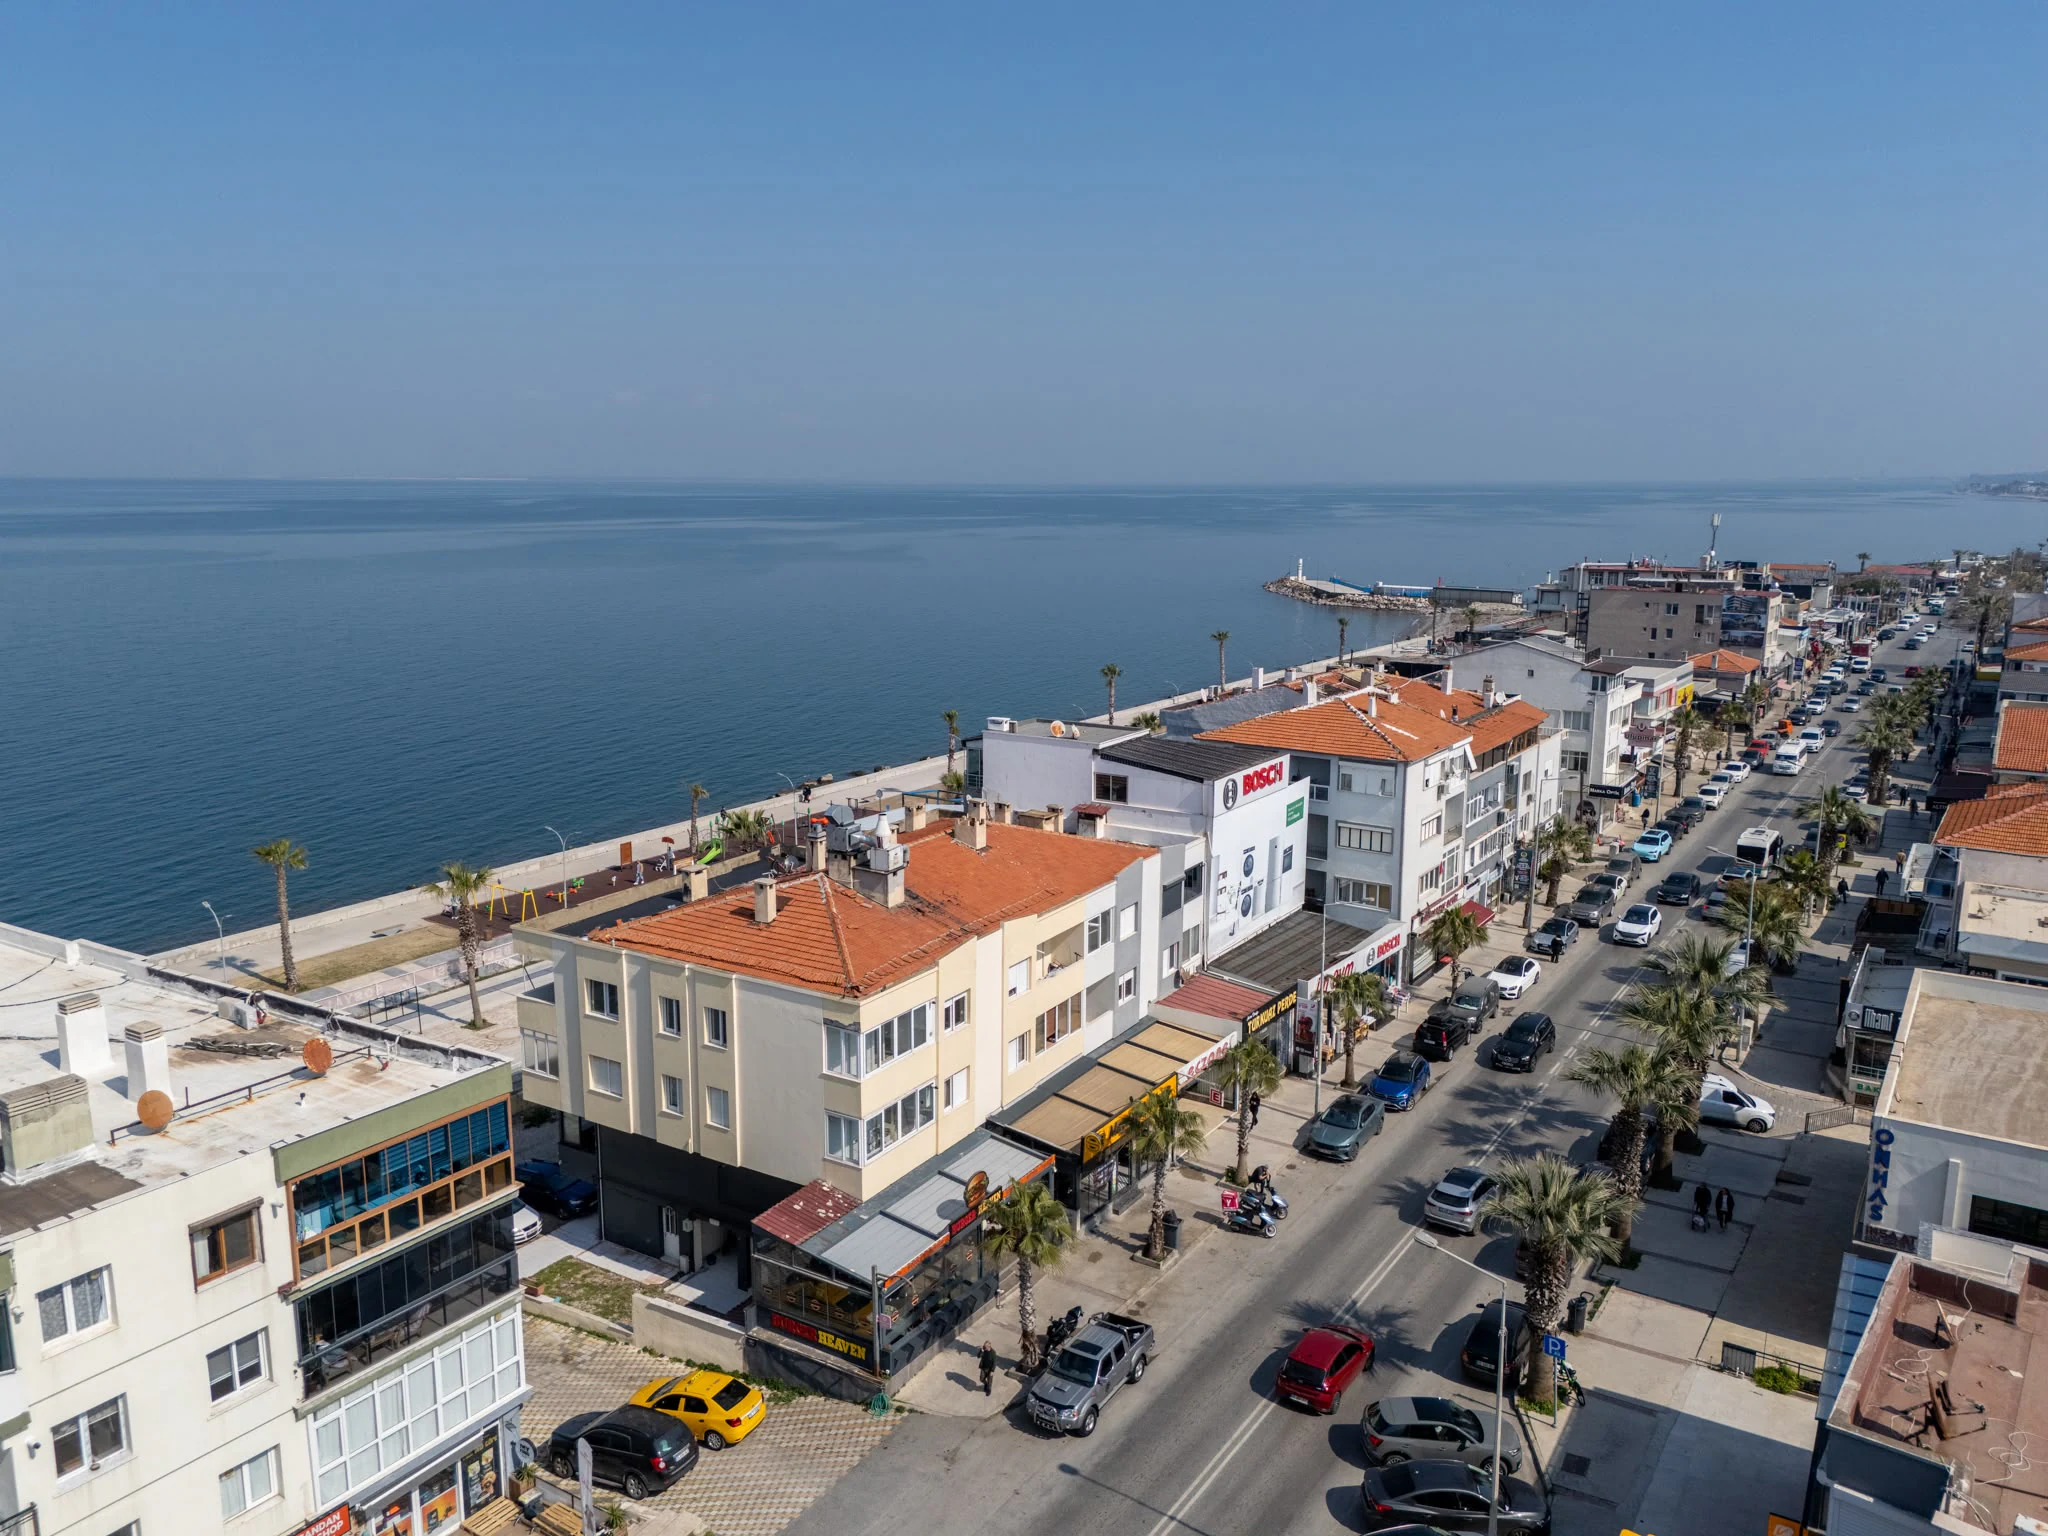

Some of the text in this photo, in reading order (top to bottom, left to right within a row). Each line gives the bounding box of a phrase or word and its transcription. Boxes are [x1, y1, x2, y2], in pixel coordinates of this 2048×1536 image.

[1243, 761, 1284, 796] BOSCH
[1377, 933, 1401, 958] BOSCH
[1277, 990, 1297, 1015] PERDE
[978, 1190, 1002, 1217] HEVEN
[771, 1312, 866, 1360] BURGER HEAVEN
[1548, 1337, 1561, 1354] P
[300, 1512, 340, 1536] ANDAN
